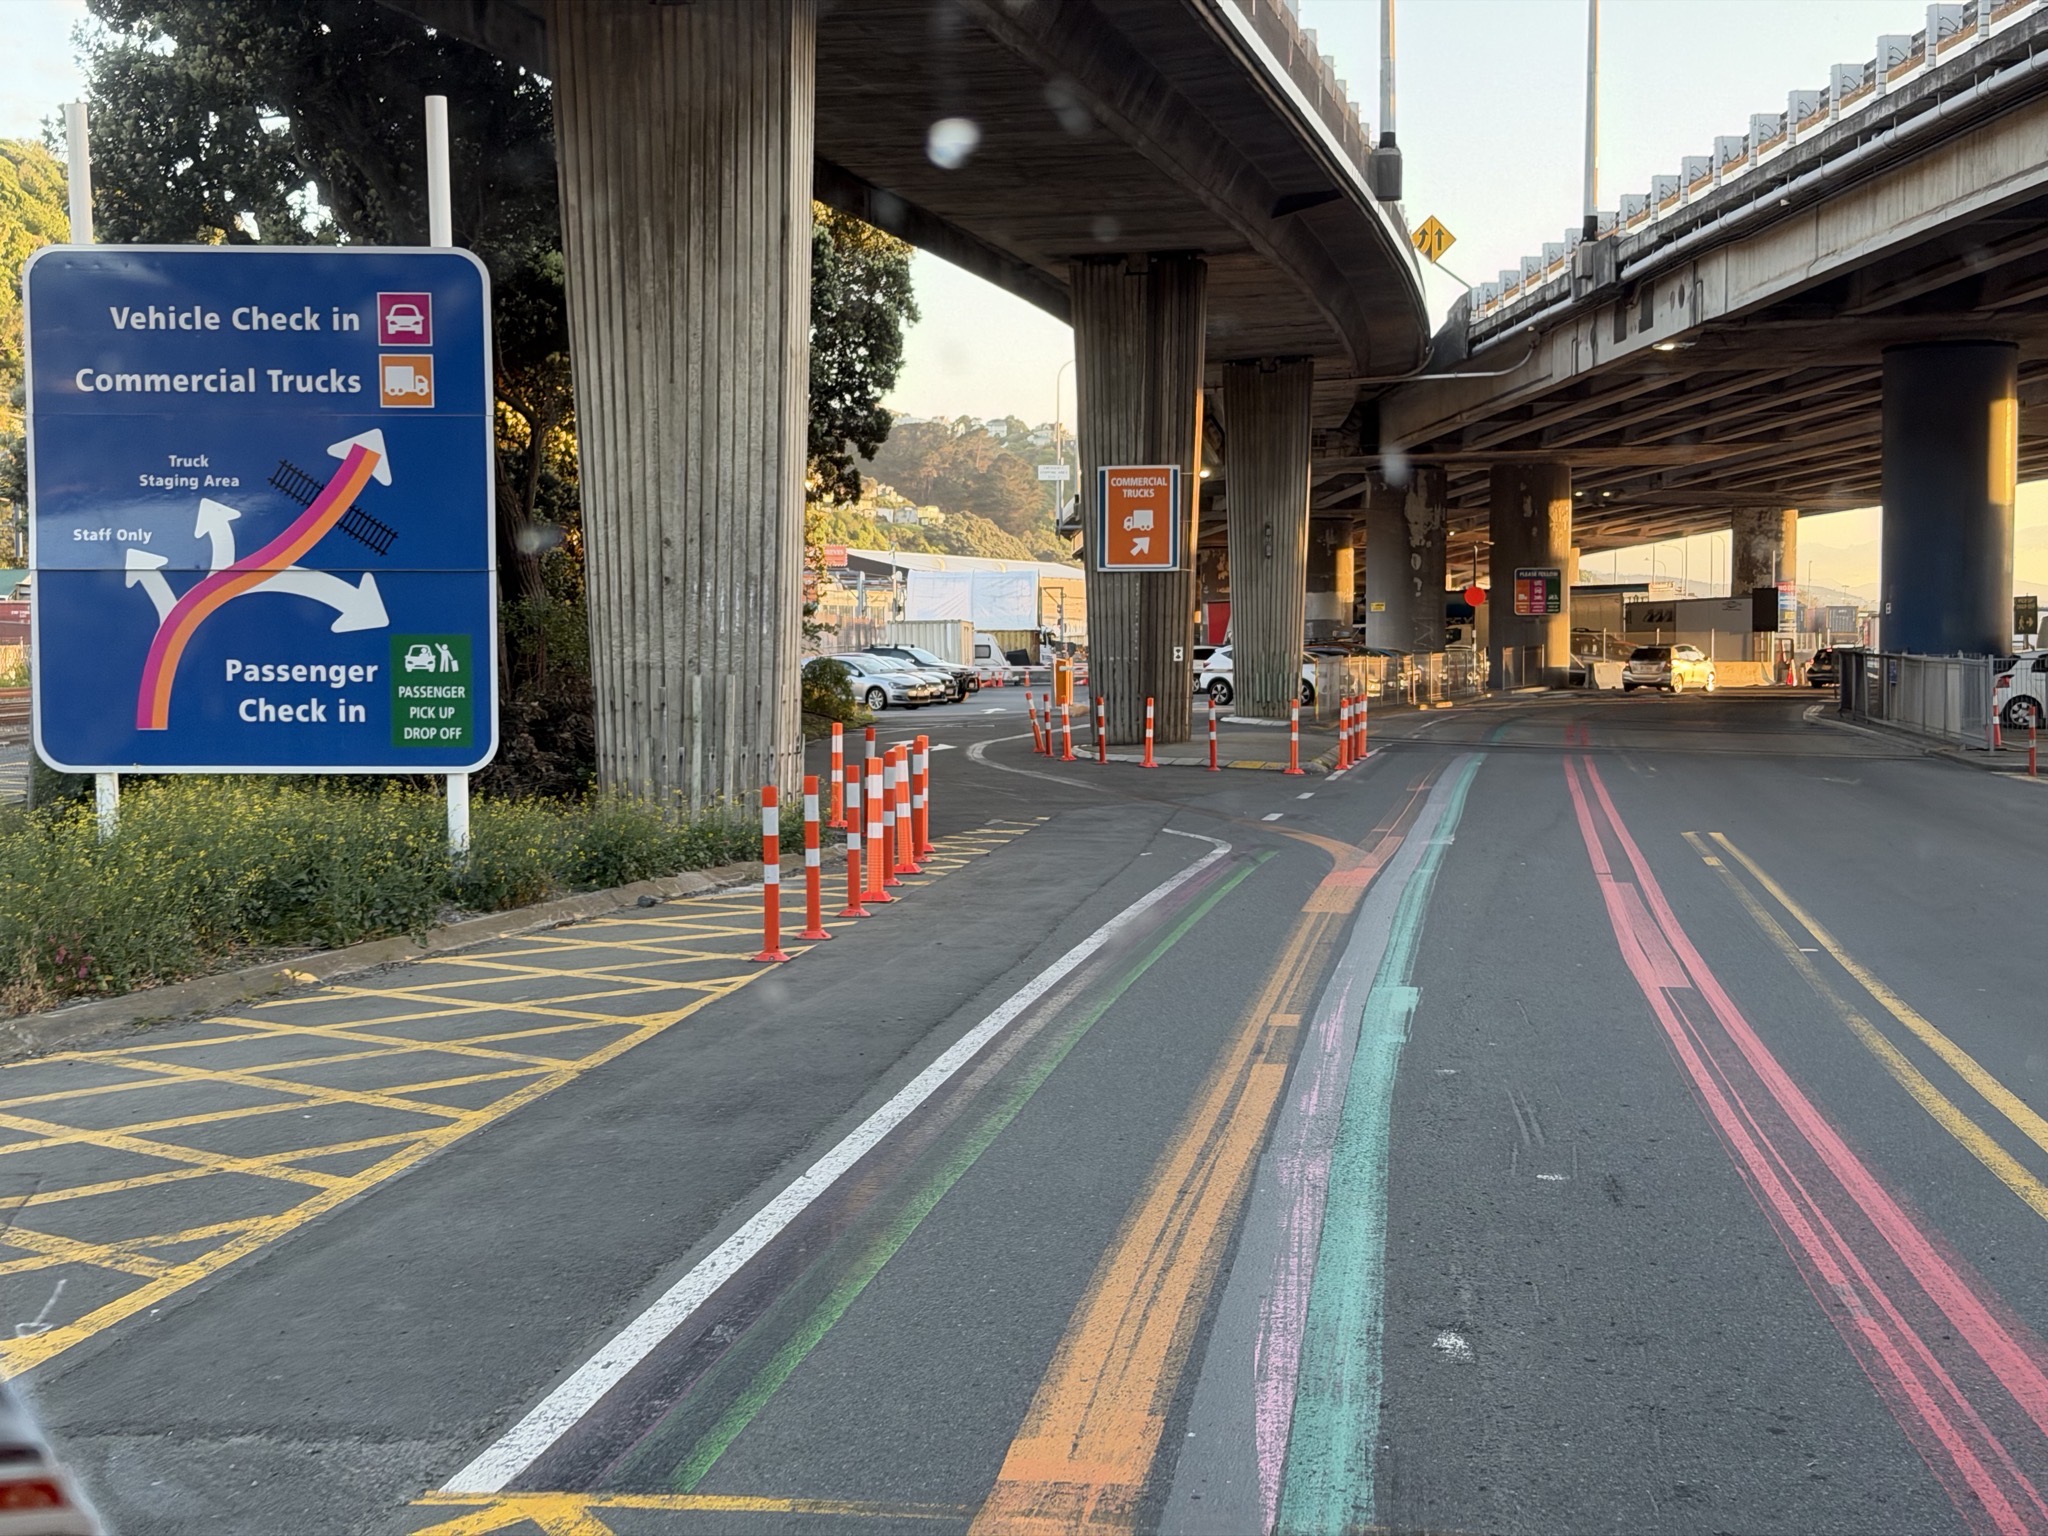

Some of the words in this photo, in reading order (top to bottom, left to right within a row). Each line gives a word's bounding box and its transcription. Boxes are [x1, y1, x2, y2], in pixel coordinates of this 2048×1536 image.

[110, 306, 220, 330] Vehicle
[232, 306, 320, 331] Check
[333, 307, 360, 331] in
[75, 368, 256, 393] Commercial
[267, 369, 362, 394] Trucks
[168, 455, 209, 468] Truck
[139, 474, 199, 490] Staging
[204, 474, 240, 488] Area
[1110, 476, 1168, 487] COMMERCIAL
[1122, 488, 1155, 498] TRUCKS
[73, 527, 112, 542] Staff
[116, 528, 153, 545] Only
[226, 659, 378, 689] Passenger
[398, 685, 466, 699] PASSENGER
[238, 697, 327, 723] Check
[338, 698, 367, 723] in
[409, 706, 435, 719] PICK
[438, 706, 456, 719] UP
[404, 727, 437, 740] DROP
[440, 727, 463, 740] OFF
